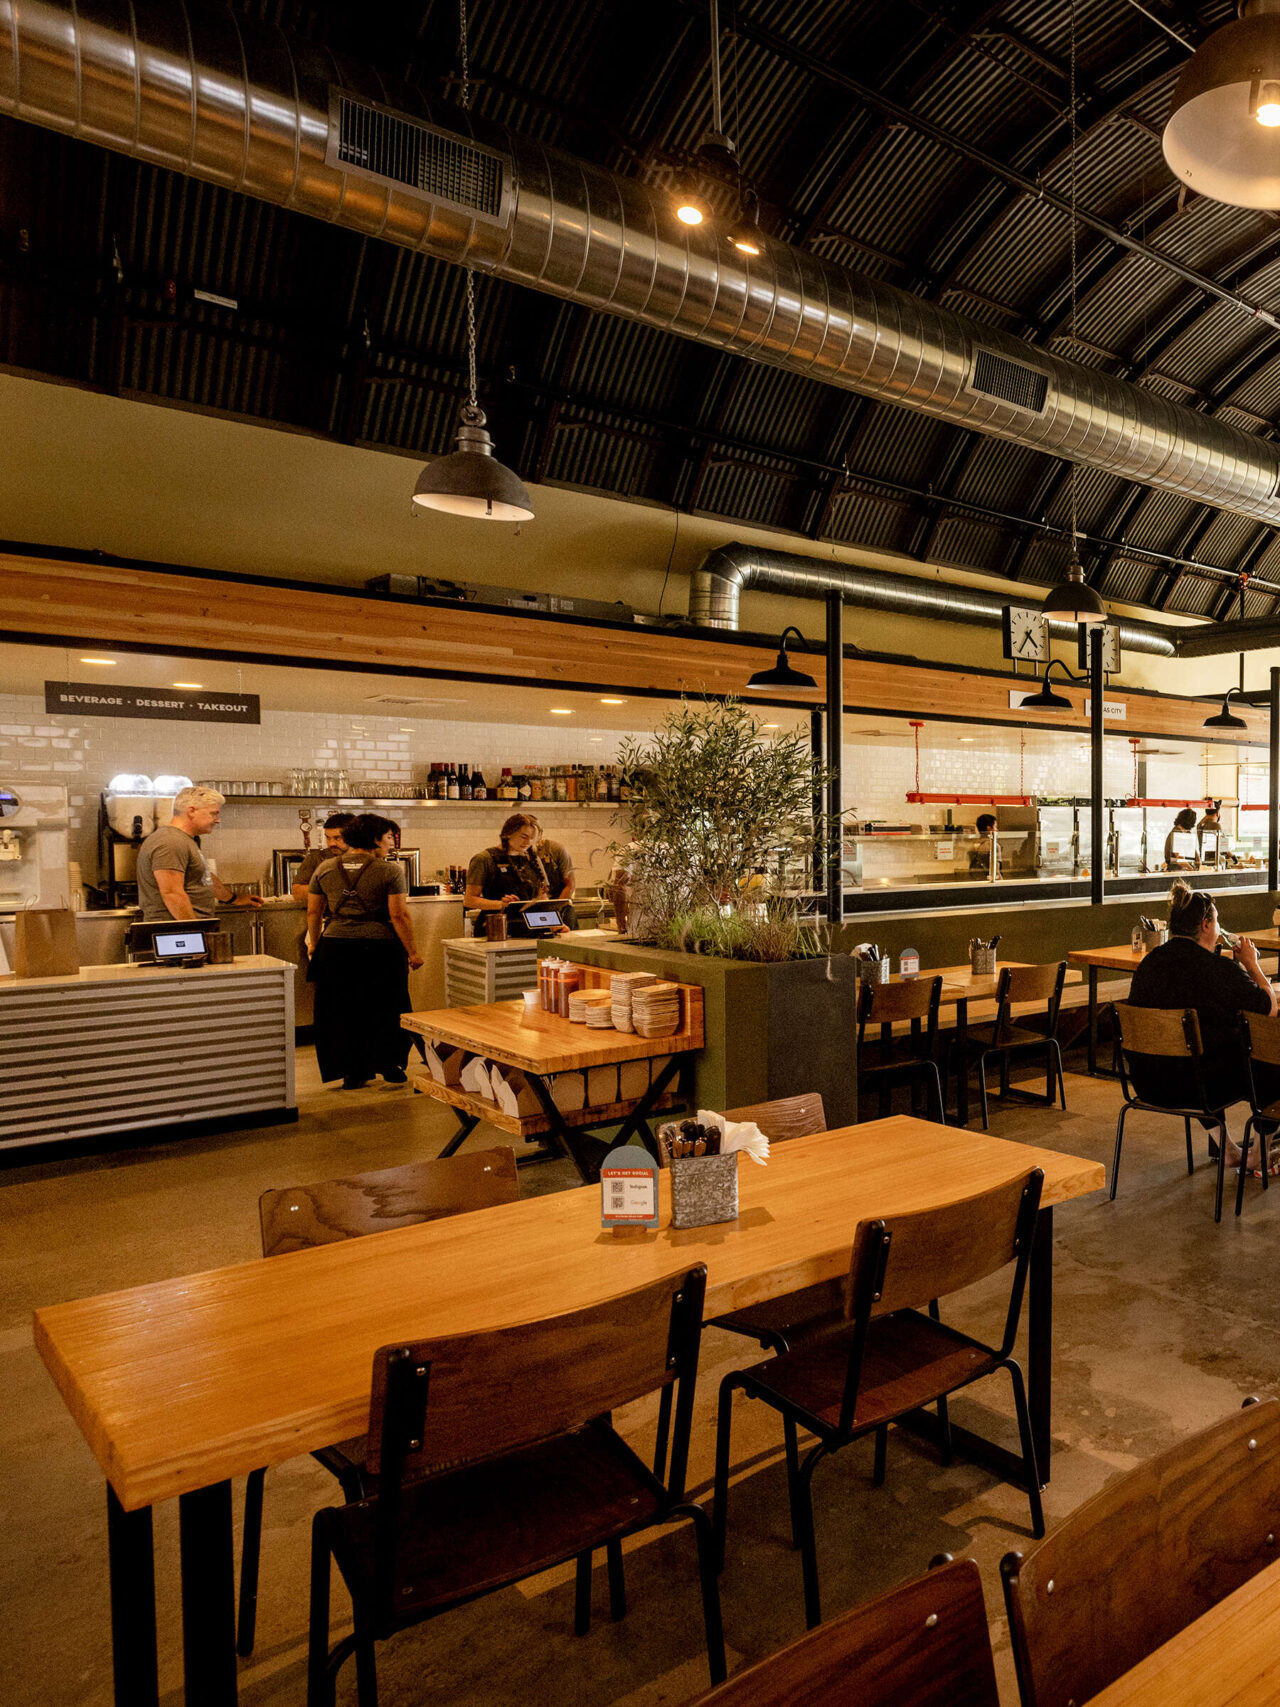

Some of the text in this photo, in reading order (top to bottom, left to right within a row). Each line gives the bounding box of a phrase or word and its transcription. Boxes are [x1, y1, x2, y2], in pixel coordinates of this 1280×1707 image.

[59, 694, 248, 713] BEVERAGE DESSERT TAKEOUT
